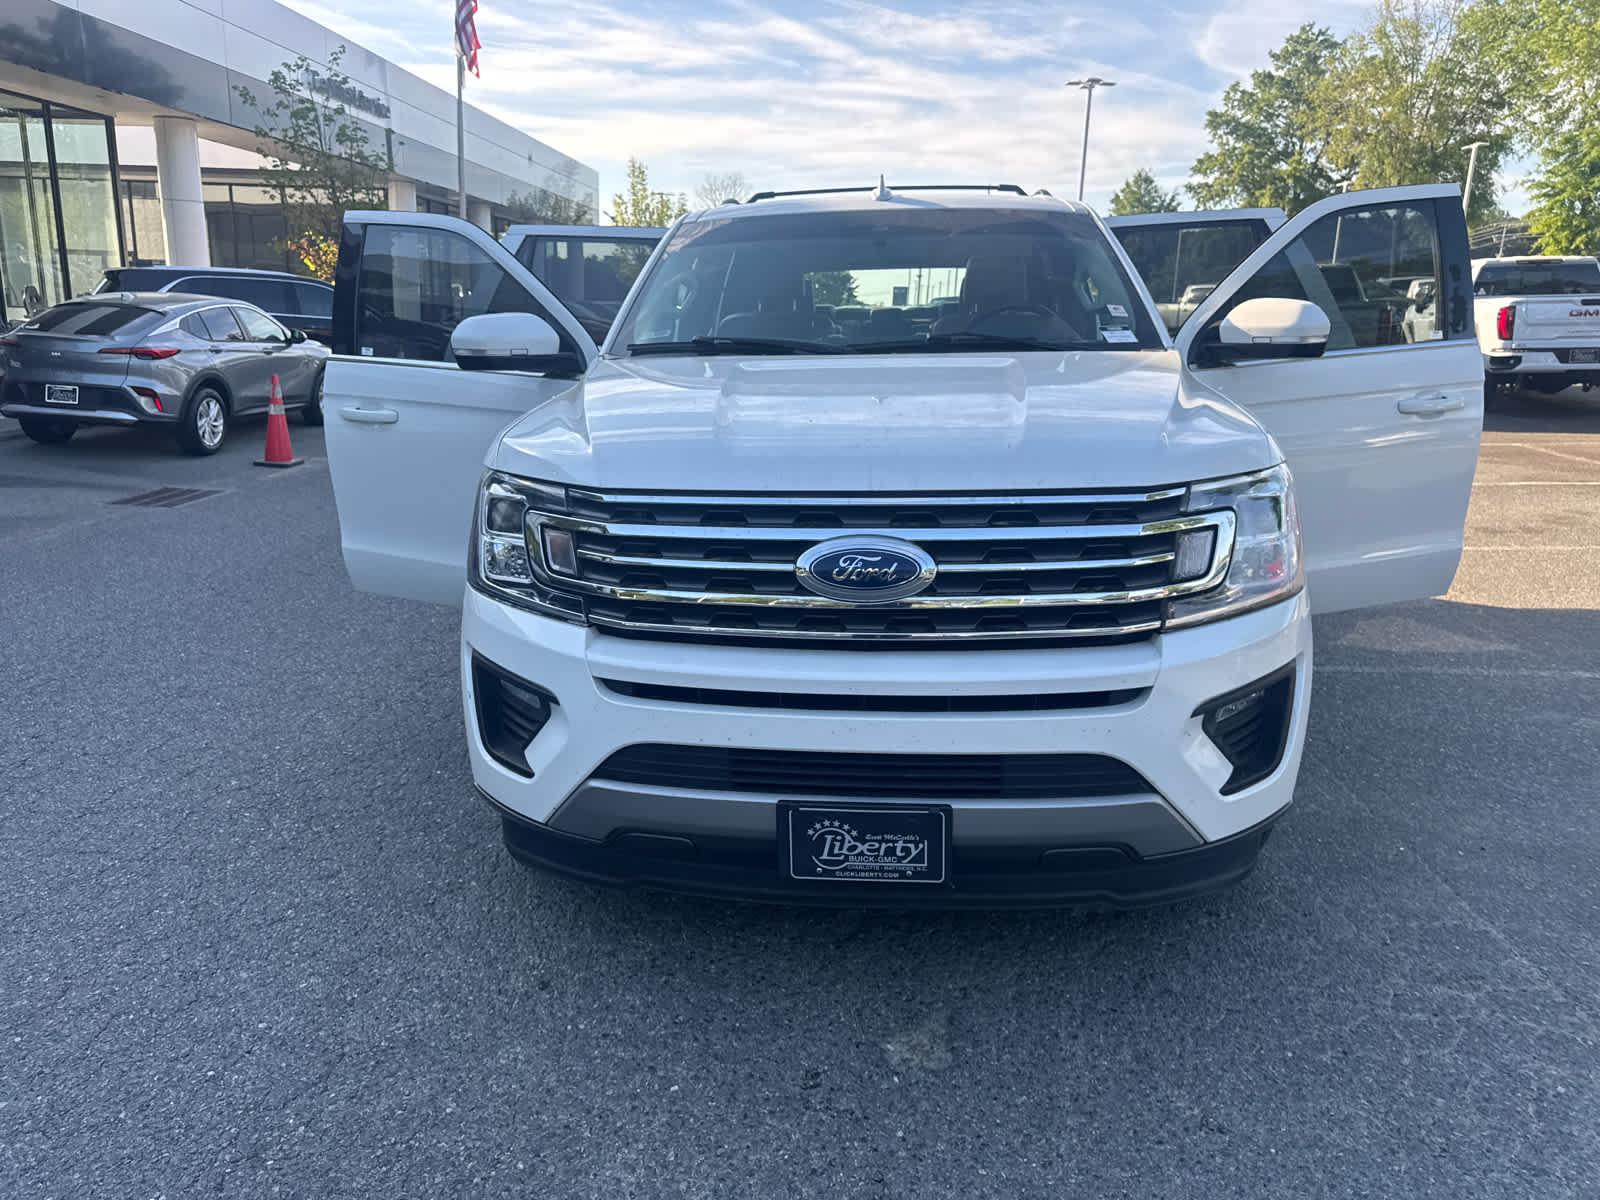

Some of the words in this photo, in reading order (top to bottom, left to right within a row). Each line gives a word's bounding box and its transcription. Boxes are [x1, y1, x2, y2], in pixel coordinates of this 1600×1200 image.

[1569, 309, 1600, 317] GM
[832, 554, 898, 581] Ford
[819, 834, 924, 864] Liberty
[848, 855, 898, 863] BUICK-GMC
[835, 870, 900, 878] CLICKLIBERTY.COM
